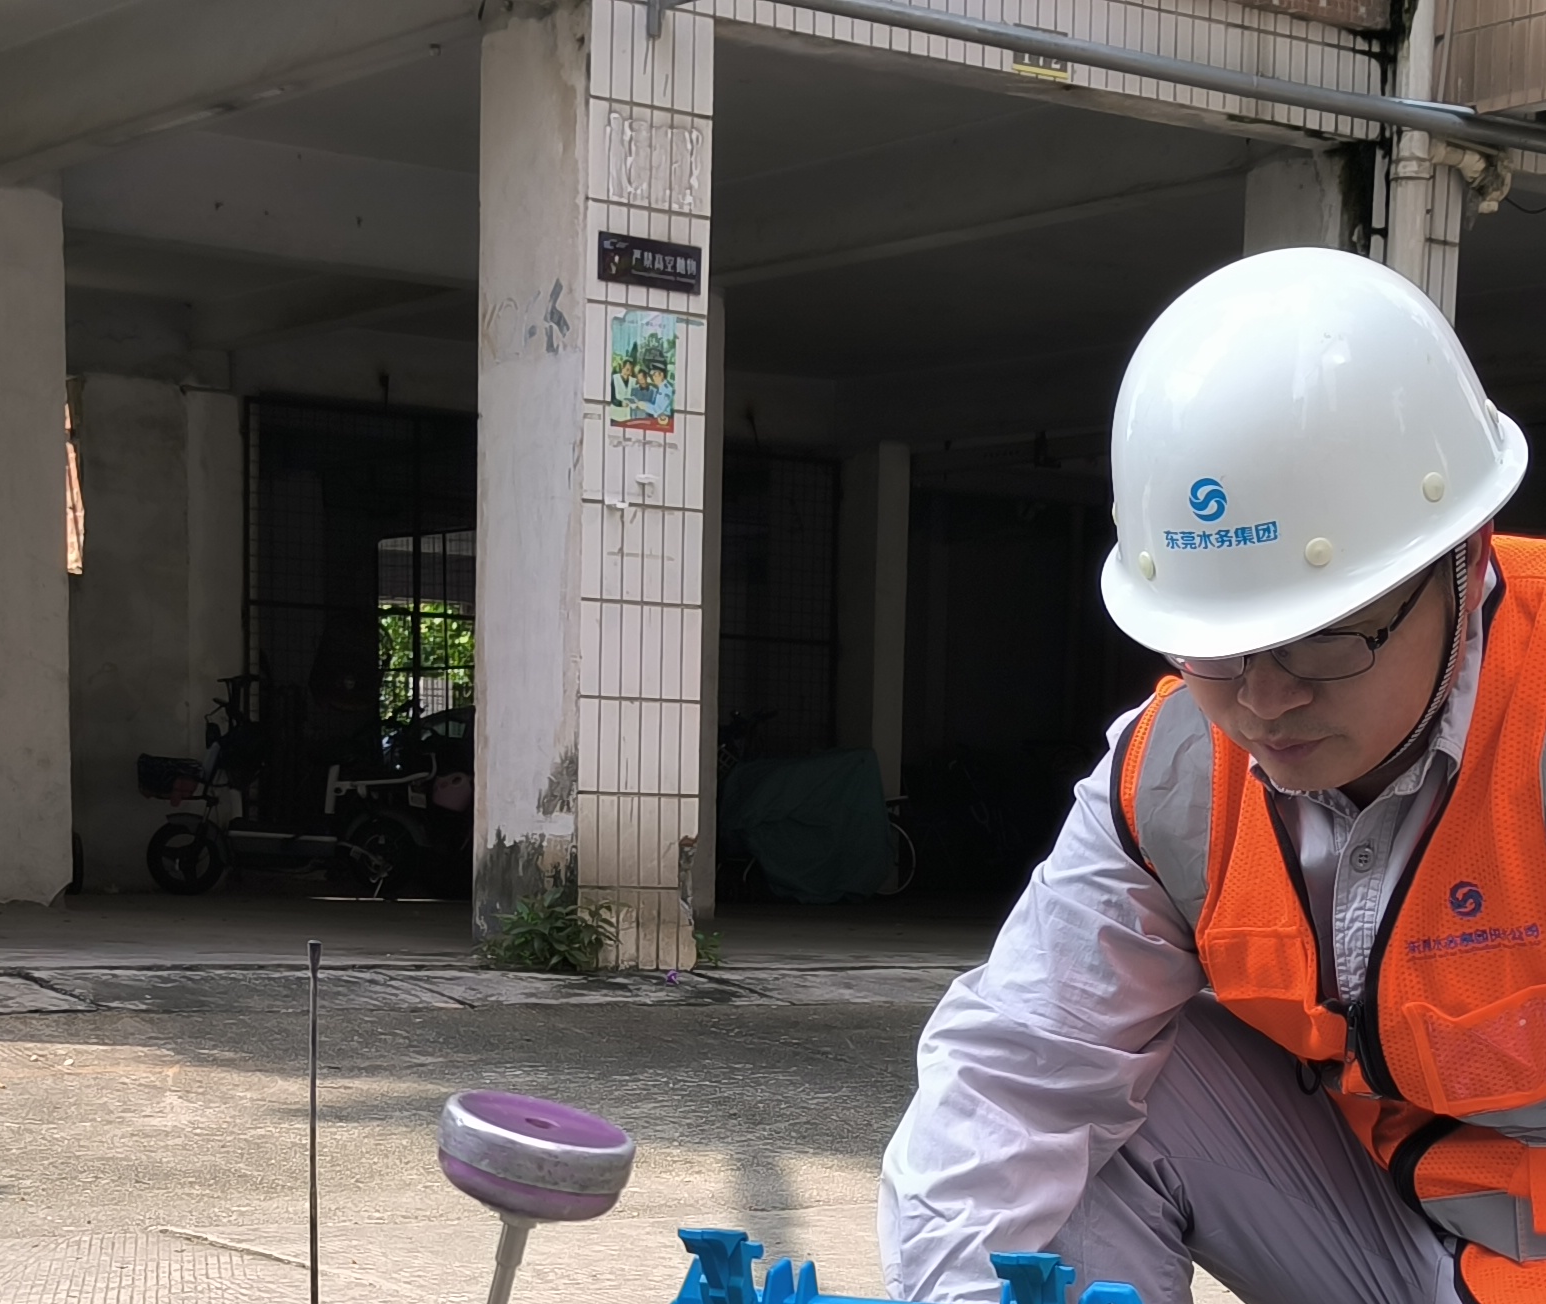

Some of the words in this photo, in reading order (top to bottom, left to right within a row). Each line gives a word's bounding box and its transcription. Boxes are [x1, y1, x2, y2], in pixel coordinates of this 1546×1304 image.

[1163, 520, 1279, 550] 东莞水务集团
